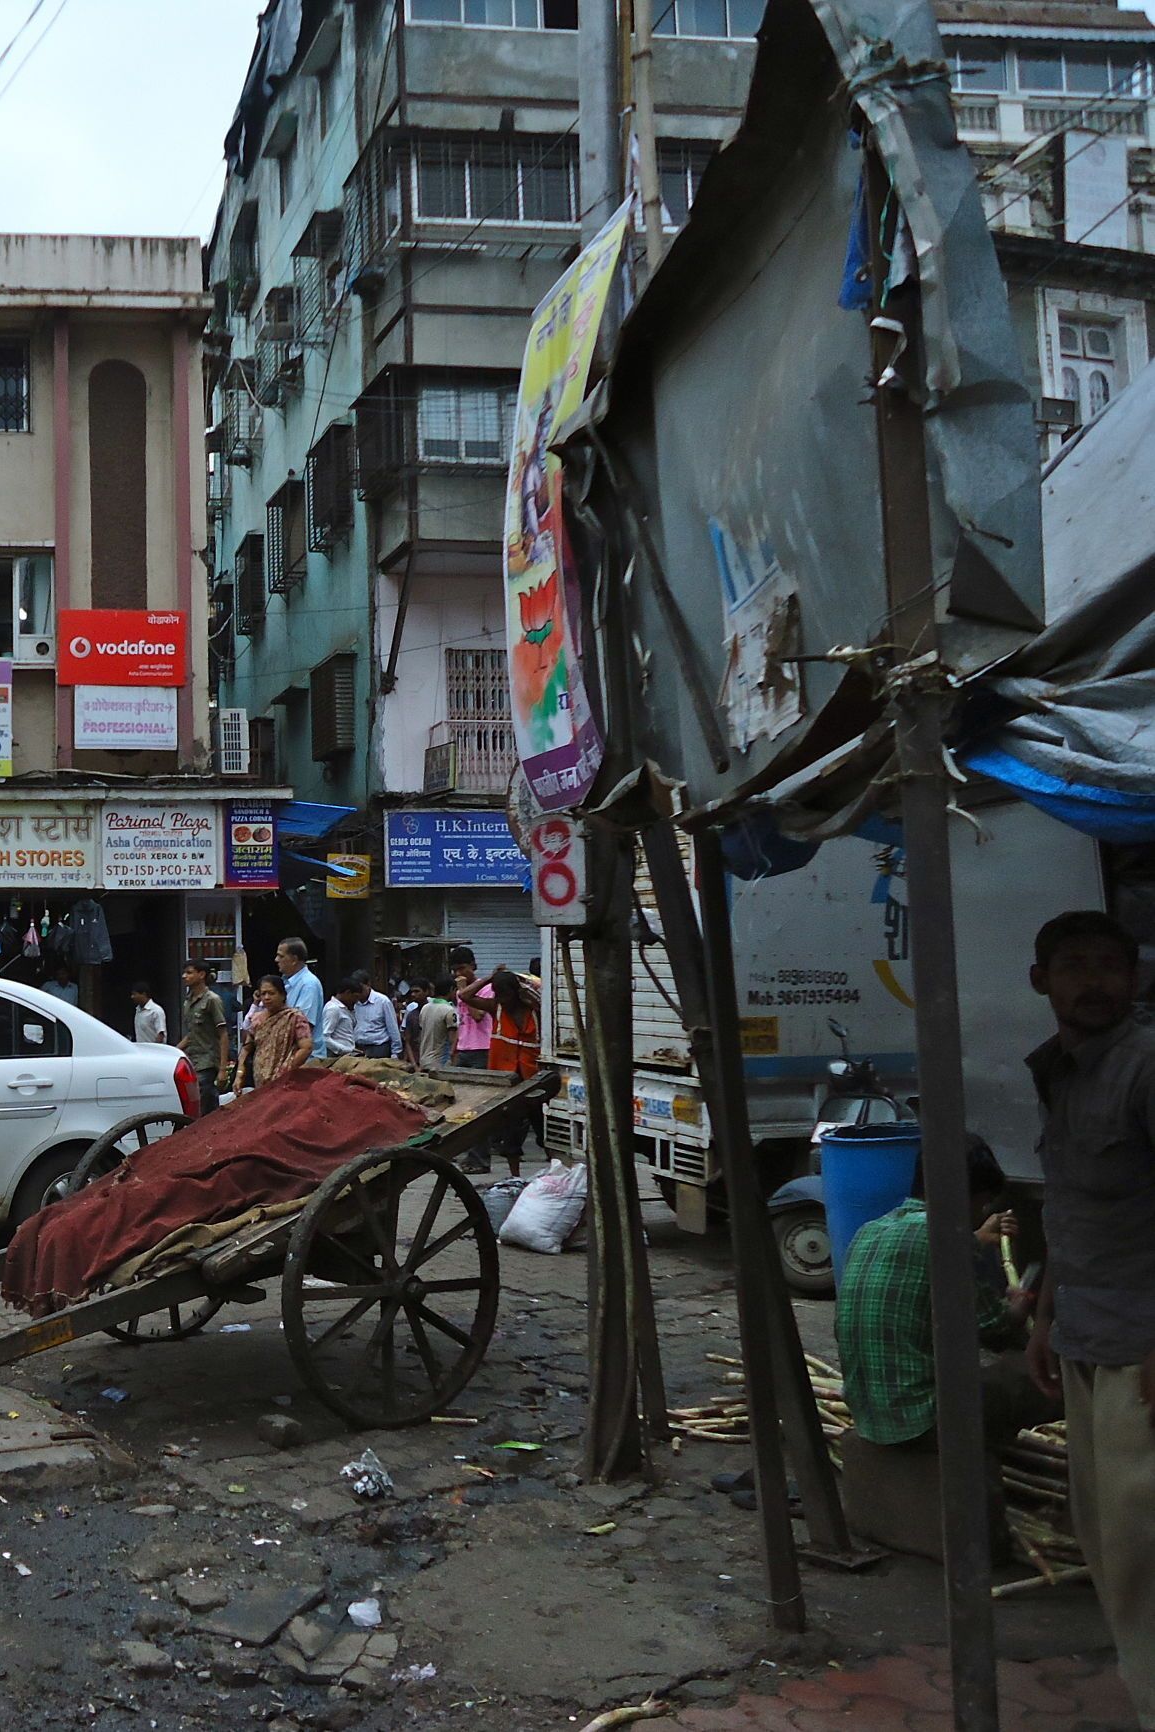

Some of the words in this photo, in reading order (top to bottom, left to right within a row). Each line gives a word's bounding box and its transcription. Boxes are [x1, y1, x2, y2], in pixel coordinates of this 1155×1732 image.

[96, 640, 176, 655] vodafone
[83, 720, 166, 733] PROFESSIONAL
[106, 812, 165, 829] Parimal
[170, 812, 212, 836] Plaza
[434, 820, 509, 832] H.K.Intern
[106, 838, 130, 848] Asha
[134, 838, 212, 848] Communication
[390, 838, 408, 846] GEMS
[410, 838, 431, 846] OCEAN
[15, 850, 85, 866] STORES
[443, 848, 464, 862] एच.
[467, 844, 482, 860] के.
[106, 865, 129, 876] STD
[135, 865, 154, 876] ISD
[160, 865, 182, 876] PCO
[188, 865, 212, 876] FAX
